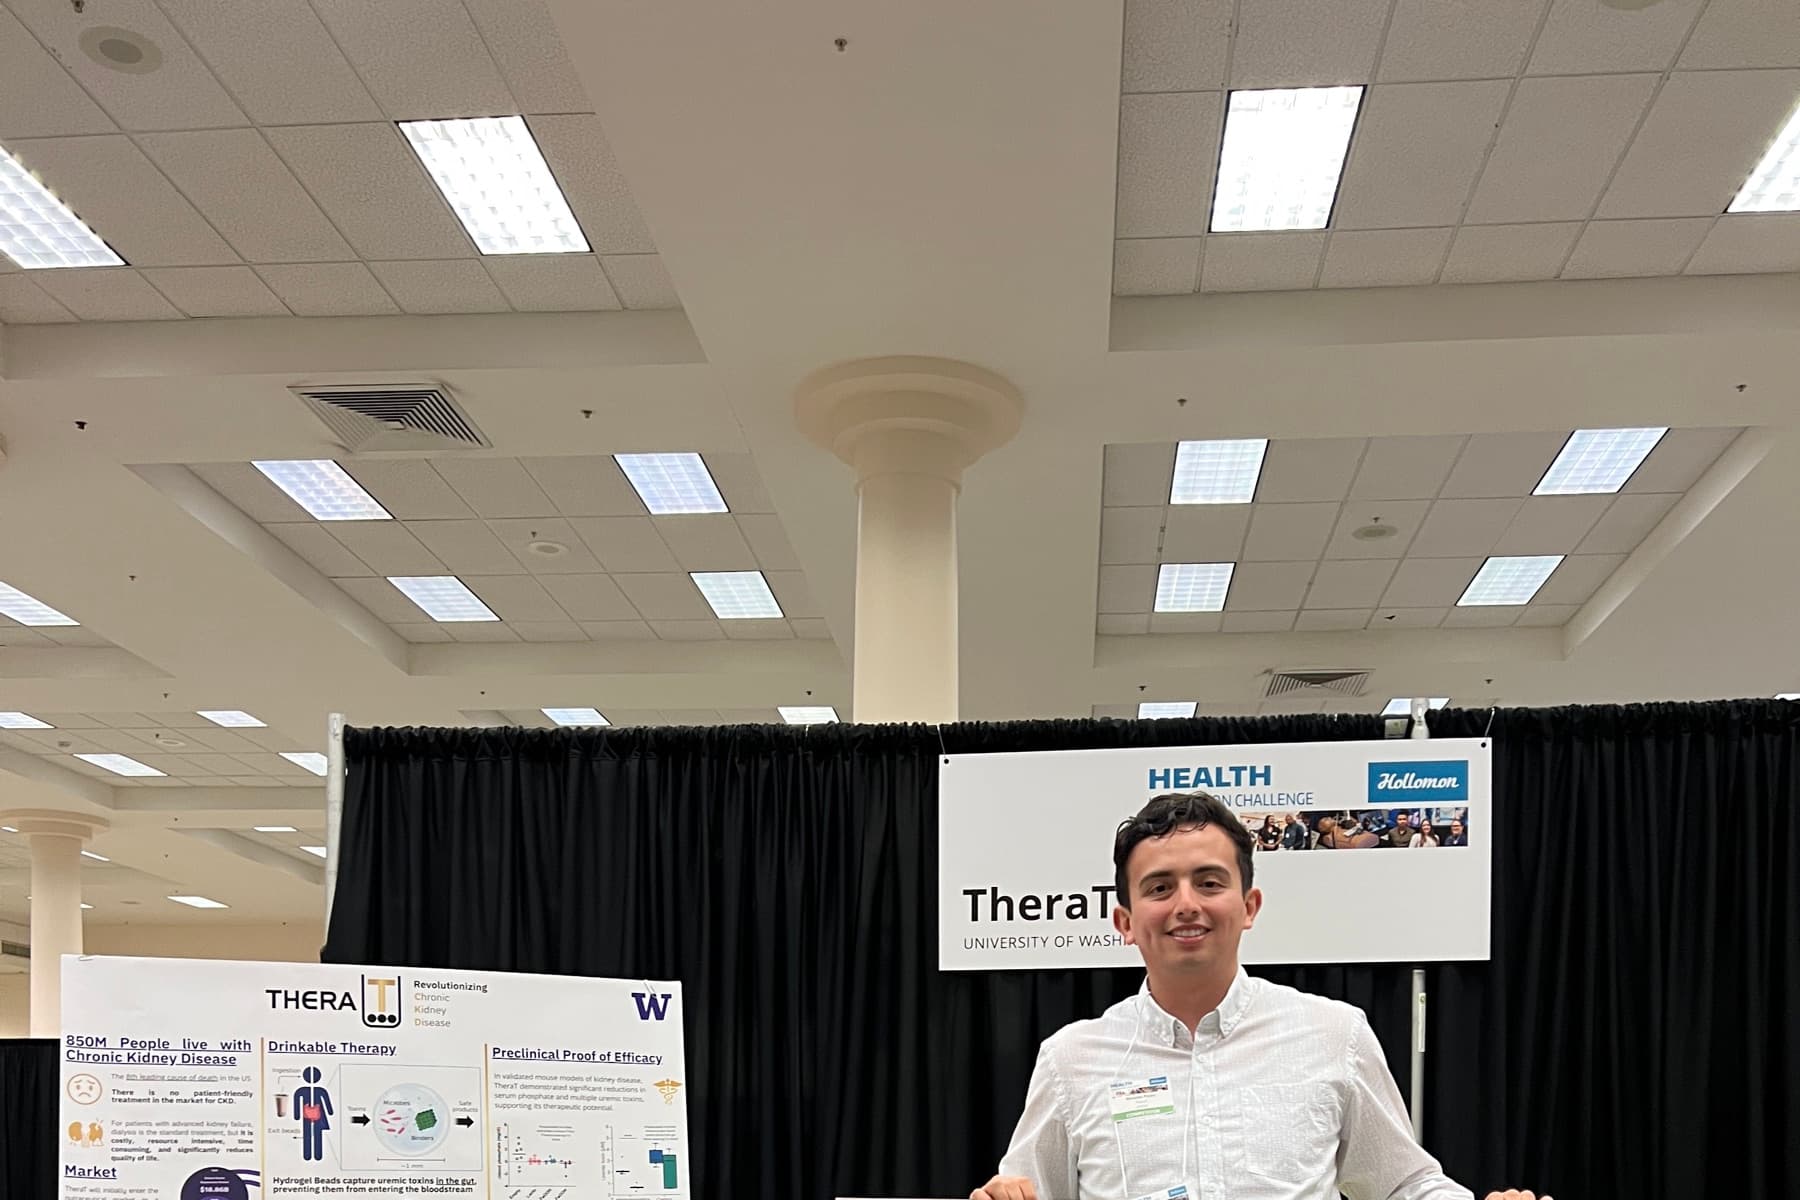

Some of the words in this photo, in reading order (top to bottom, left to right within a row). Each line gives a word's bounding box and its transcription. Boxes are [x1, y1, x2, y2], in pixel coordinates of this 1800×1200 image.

[1149, 765, 1271, 789] HEALTH
[1377, 773, 1459, 791] Hollomon
[1235, 792, 1313, 807] CHALLENGE
[963, 886, 1118, 921] TheraT
[964, 936, 1048, 949] UNIVERSITY
[1054, 936, 1073, 947] OF
[414, 981, 488, 993] Revolutionizing
[266, 990, 356, 1010] THERA
[414, 993, 450, 1002] Chronic
[414, 1006, 446, 1016] Kidney
[632, 993, 672, 1020] W
[414, 1019, 450, 1027] Disease
[66, 1035, 107, 1047] 850M
[120, 1038, 169, 1050] People
[183, 1039, 207, 1049] live
[220, 1040, 251, 1050] with
[269, 1041, 336, 1053] Drinkable
[341, 1043, 396, 1056] Therapy
[66, 1050, 122, 1063] Chronic
[127, 1053, 177, 1065] Kidney
[182, 1054, 236, 1064] Disease
[493, 1047, 559, 1059] Preclinical
[564, 1050, 595, 1061] Proof
[599, 1051, 611, 1061] of
[615, 1052, 662, 1065] Efficacy
[194, 1090, 252, 1098] patient-friendly
[518, 1093, 554, 1101] phosphate
[495, 1102, 531, 1110] supporting
[65, 1166, 116, 1178] Market
[273, 1177, 312, 1186] Hydrogel
[343, 1177, 375, 1186] capture
[273, 1186, 320, 1194] preventing
[369, 1186, 403, 1194] entering
